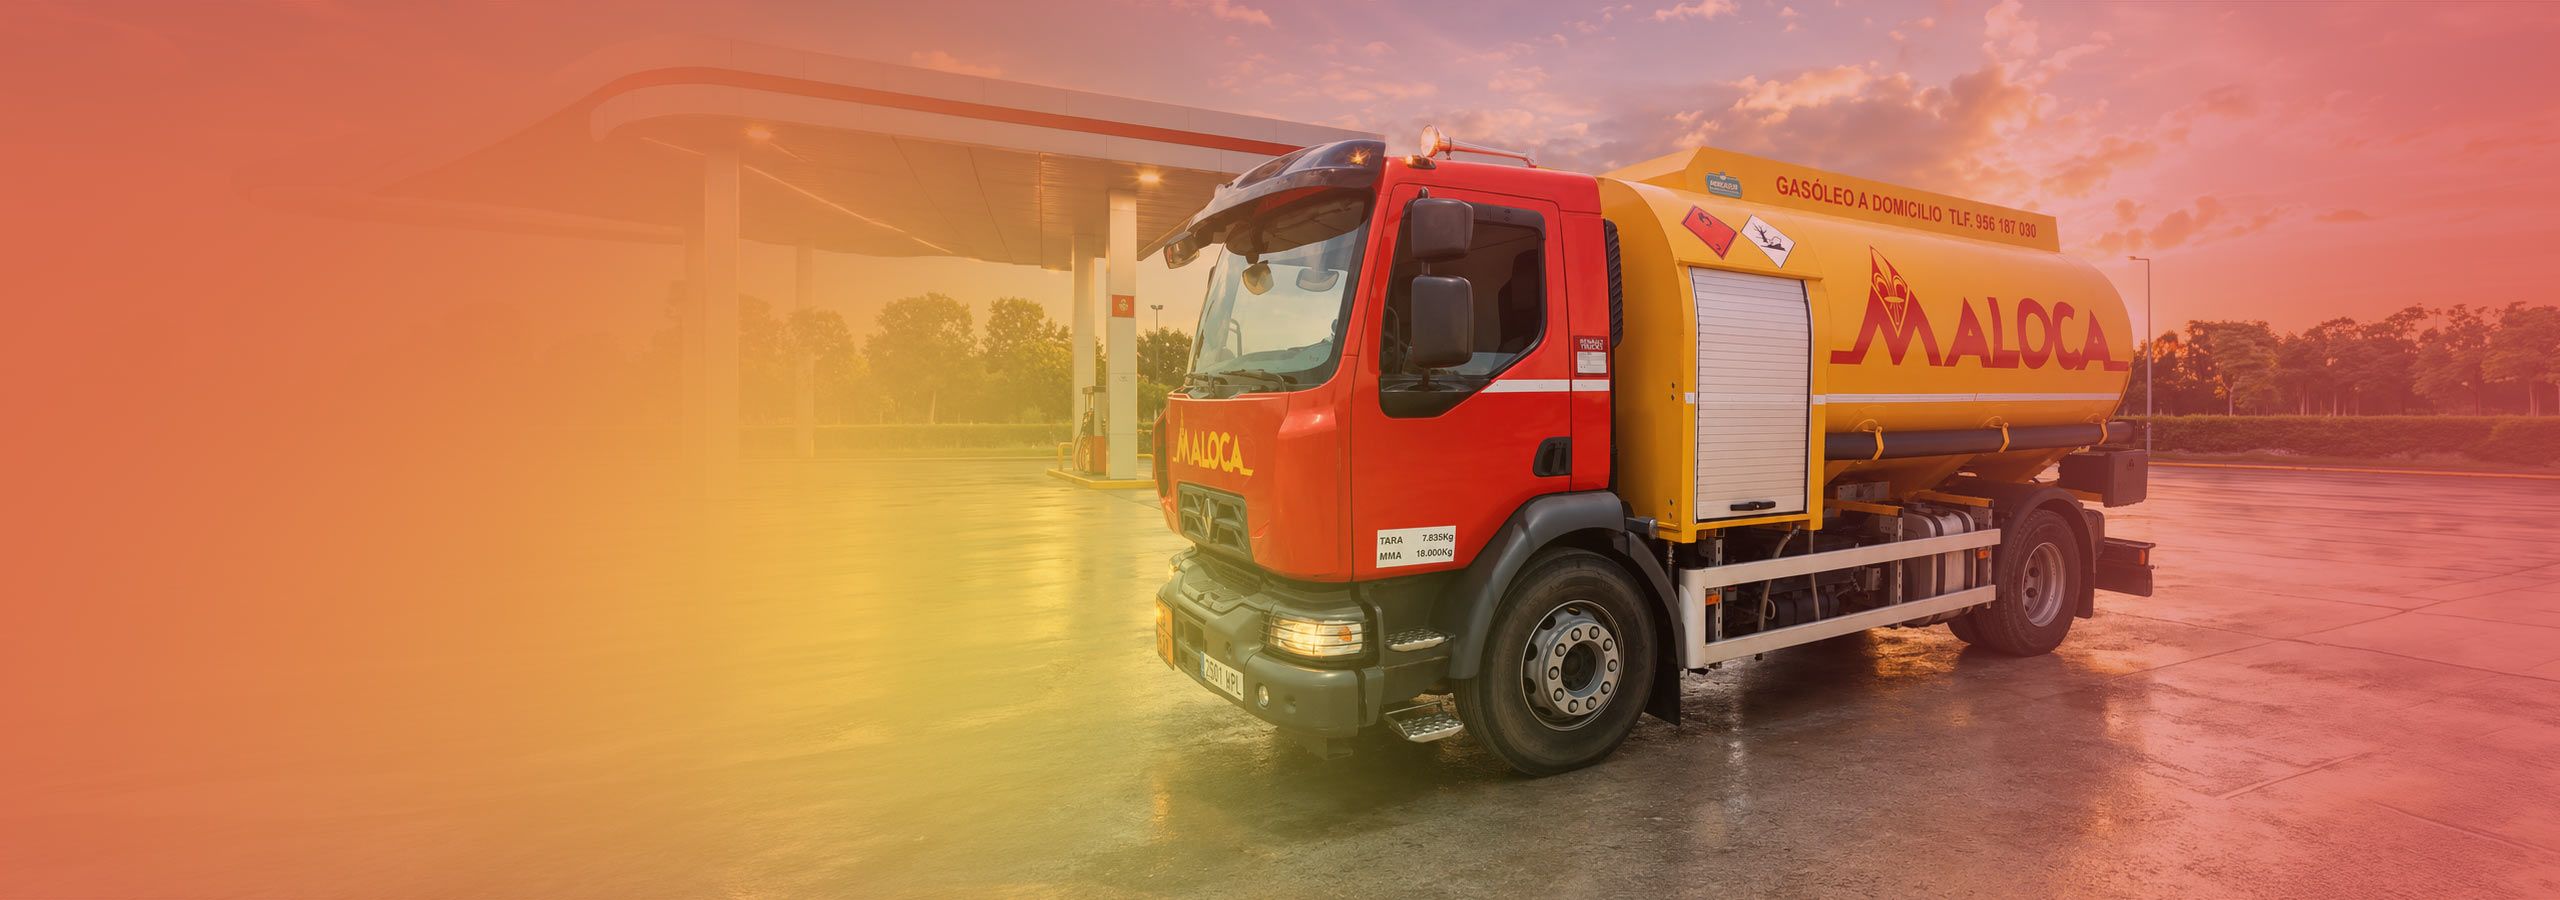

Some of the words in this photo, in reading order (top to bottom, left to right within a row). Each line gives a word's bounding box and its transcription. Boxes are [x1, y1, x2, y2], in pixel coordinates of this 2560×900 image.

[1776, 176, 1854, 207] GASÓLEO
[1858, 192, 1868, 210] A
[1872, 194, 1942, 222] DOMICILIO
[1948, 208, 1973, 228] TLF.
[1975, 213, 1995, 232] 956
[1999, 218, 2016, 235] 187
[2019, 222, 2037, 239] 030
[1830, 245, 2129, 371] MALOCA
[1172, 407, 1254, 477] MALOCA
[1380, 536, 1403, 545] TARA
[1422, 533, 1454, 543] 7.835Kg
[1380, 551, 1402, 561] MMA
[1416, 548, 1453, 558] 18.000Kg
